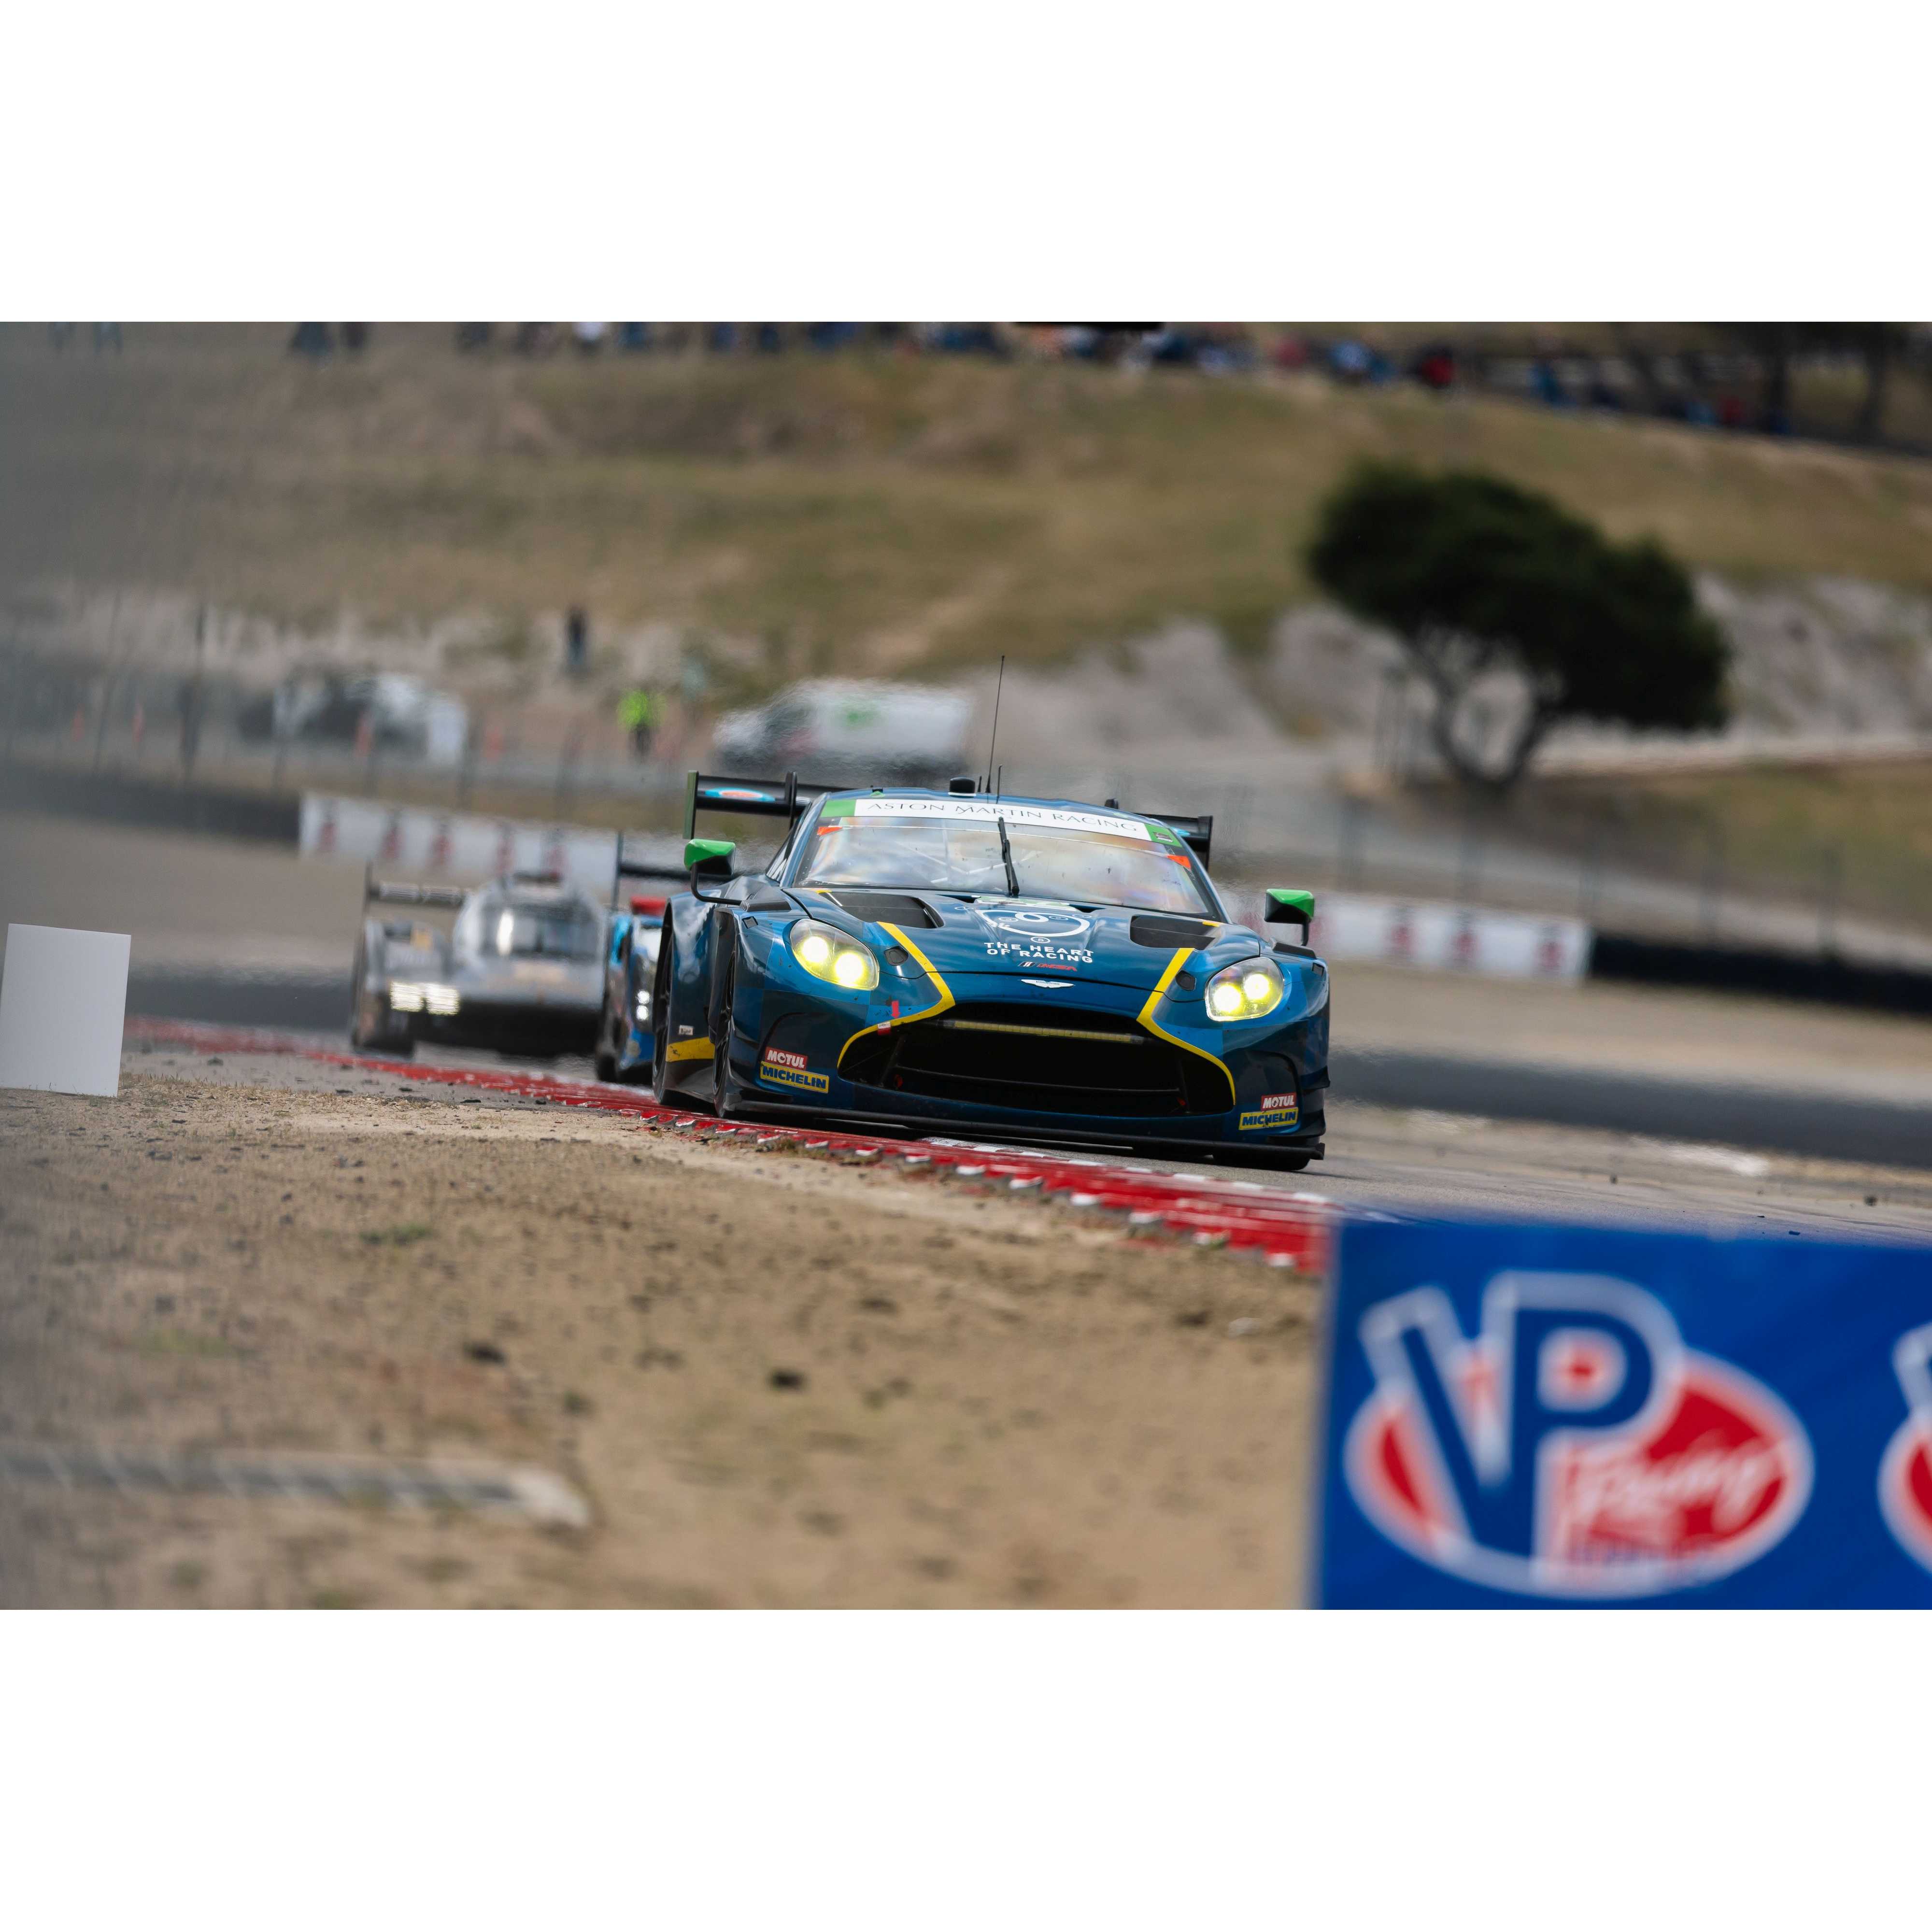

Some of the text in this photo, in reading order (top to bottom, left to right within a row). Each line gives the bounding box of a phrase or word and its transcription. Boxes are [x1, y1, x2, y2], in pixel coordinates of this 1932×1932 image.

[868, 803, 1136, 831] ASTON MARTIN RACING
[983, 941, 1094, 957] THE HEART
[1019, 950, 1093, 963] RACING
[767, 1049, 805, 1068] MOTUL
[762, 1065, 826, 1089] MICHELIN
[1262, 1095, 1295, 1109] MOTUL
[1242, 1111, 1296, 1126] MICHELIN
[1369, 1280, 1678, 1565] VP
